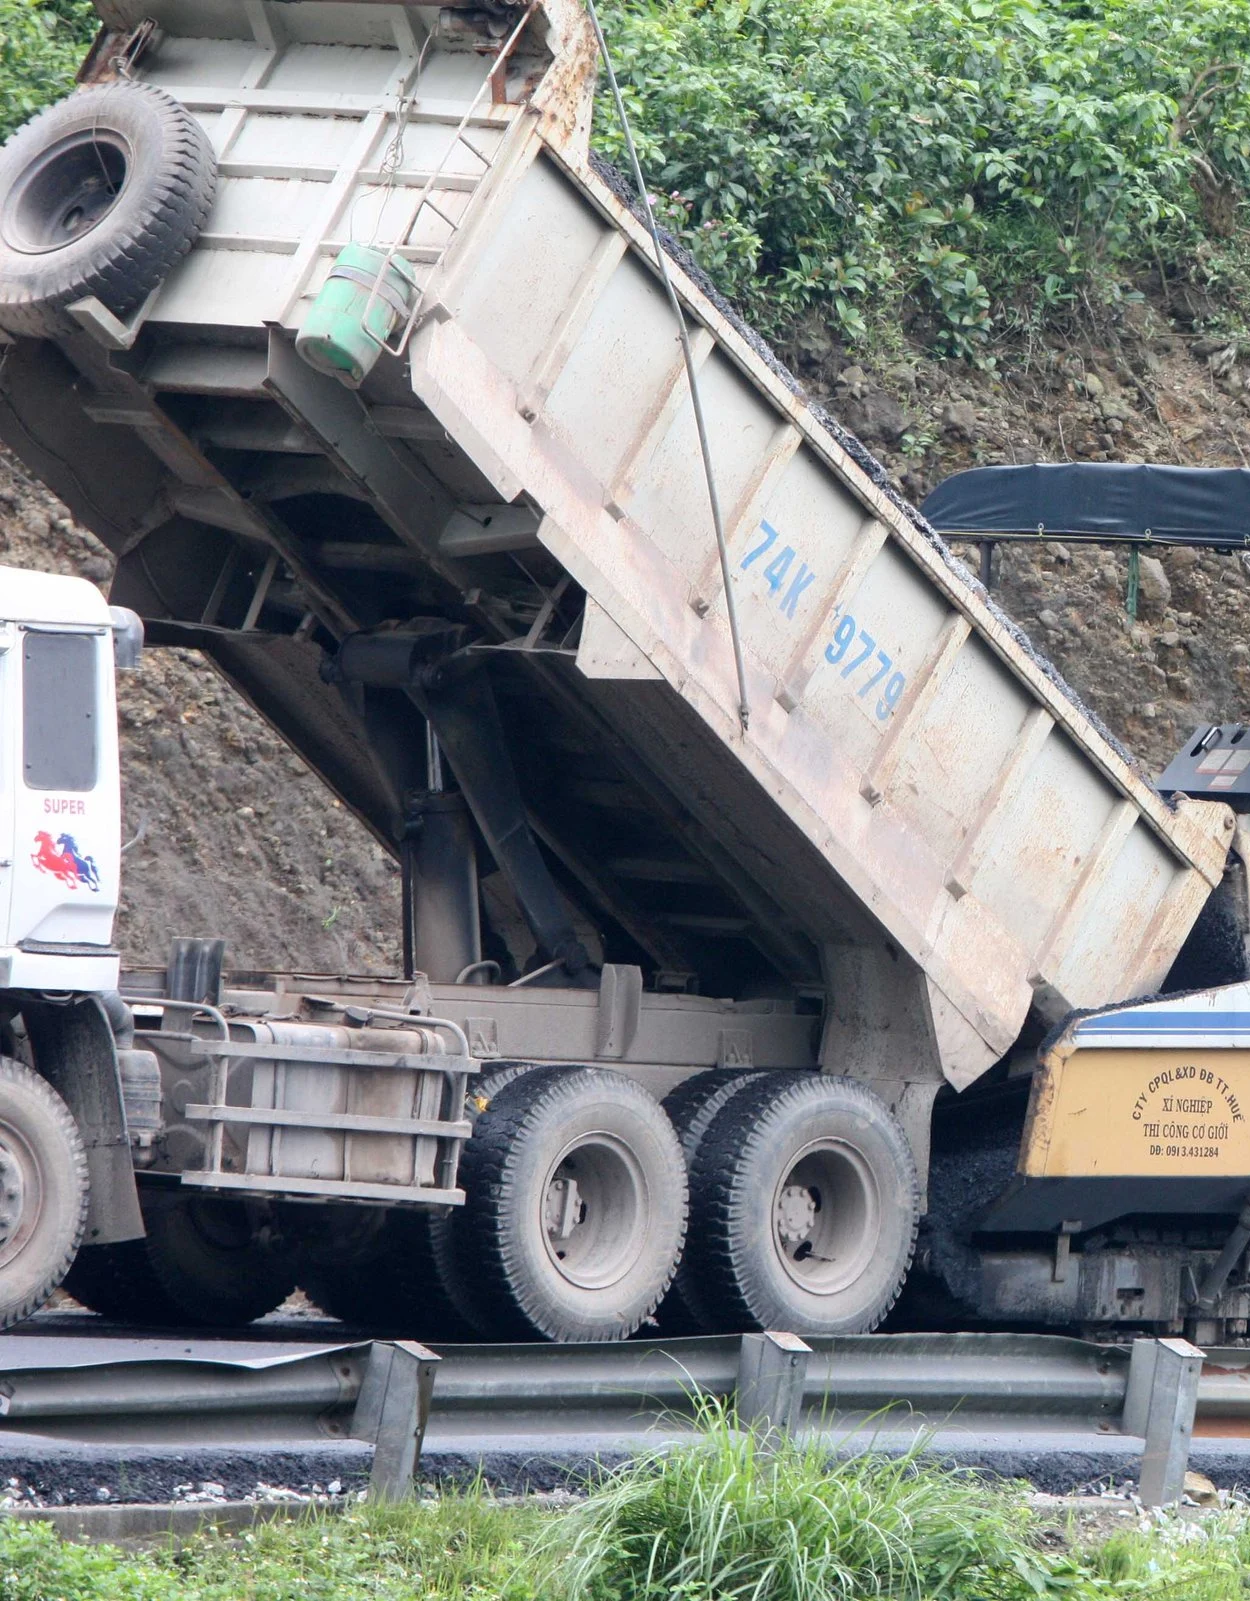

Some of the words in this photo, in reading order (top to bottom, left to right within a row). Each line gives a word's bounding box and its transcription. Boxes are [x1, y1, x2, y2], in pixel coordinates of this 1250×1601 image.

[740, 519, 816, 621] 74K
[824, 615, 906, 721] 9779
[44, 798, 85, 815] SUPER
[1132, 1092, 1148, 1120] CTY
[1175, 1096, 1213, 1117] NGHIỆP
[1162, 1121, 1189, 1138] CÔNG
